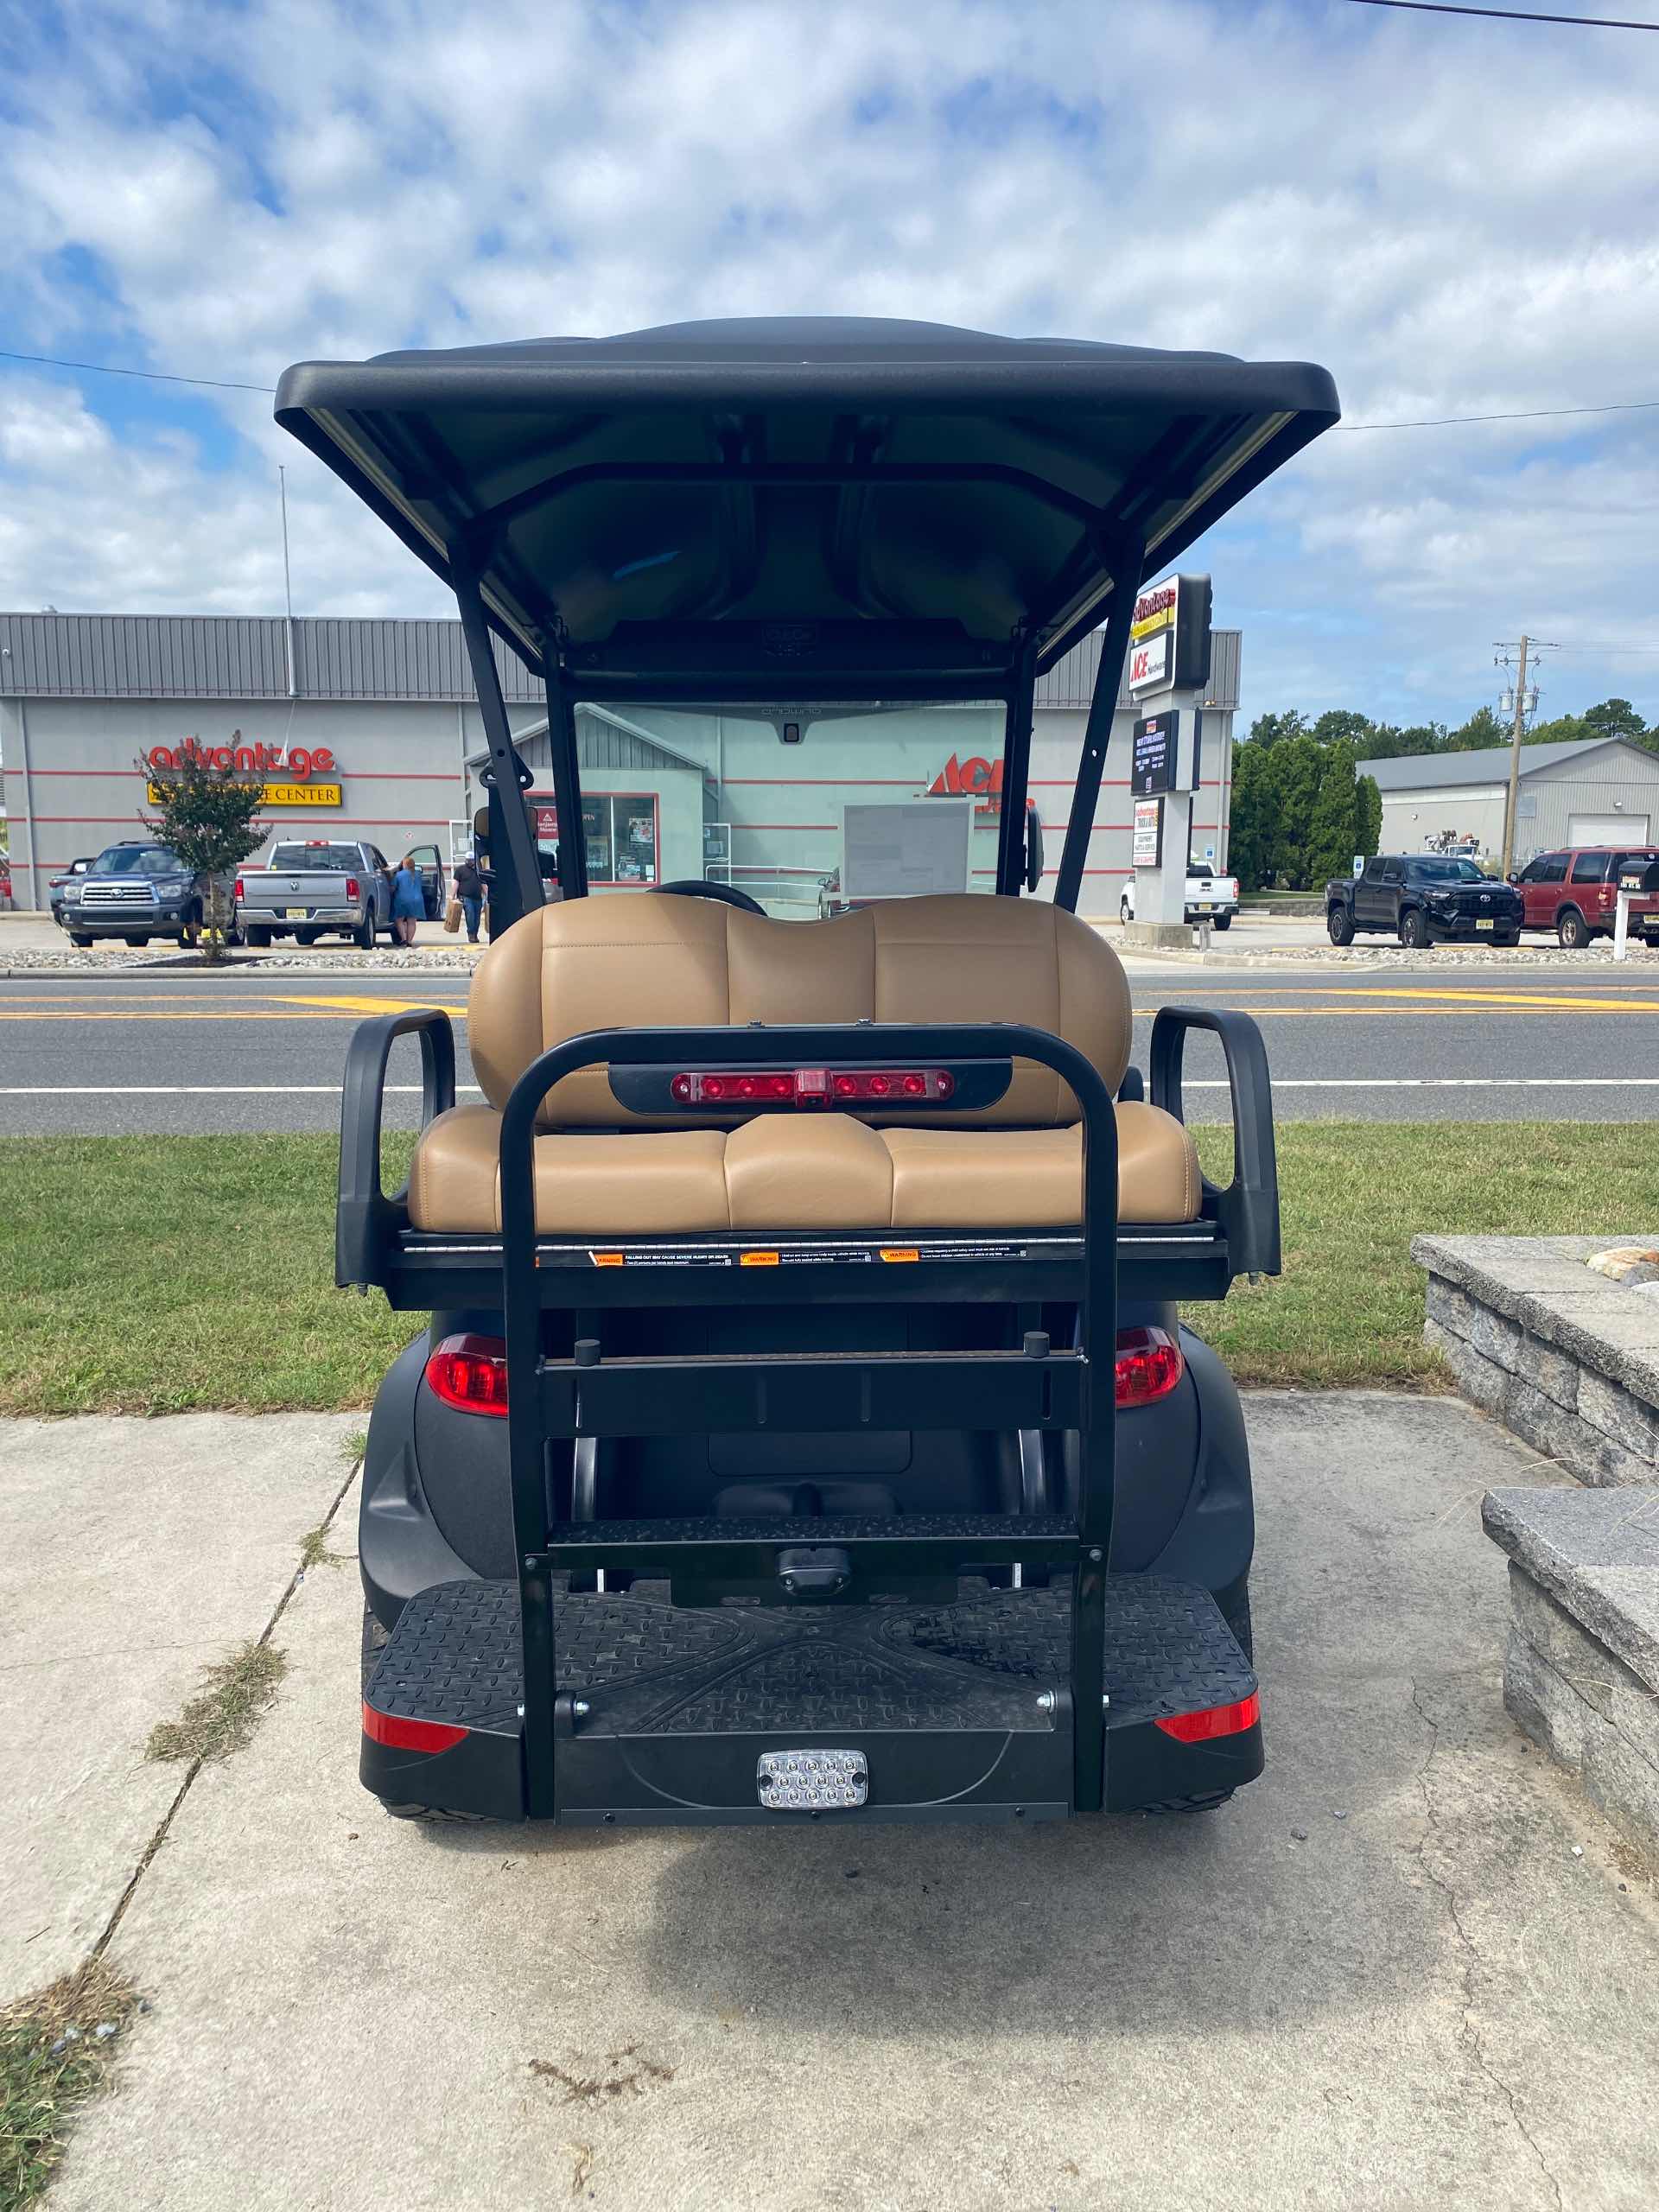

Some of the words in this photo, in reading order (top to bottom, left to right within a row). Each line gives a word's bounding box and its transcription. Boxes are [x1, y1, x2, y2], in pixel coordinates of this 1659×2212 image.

[1131, 652, 1148, 683] ACE
[149, 737, 335, 781] advantage
[275, 788, 335, 801] CENTER
